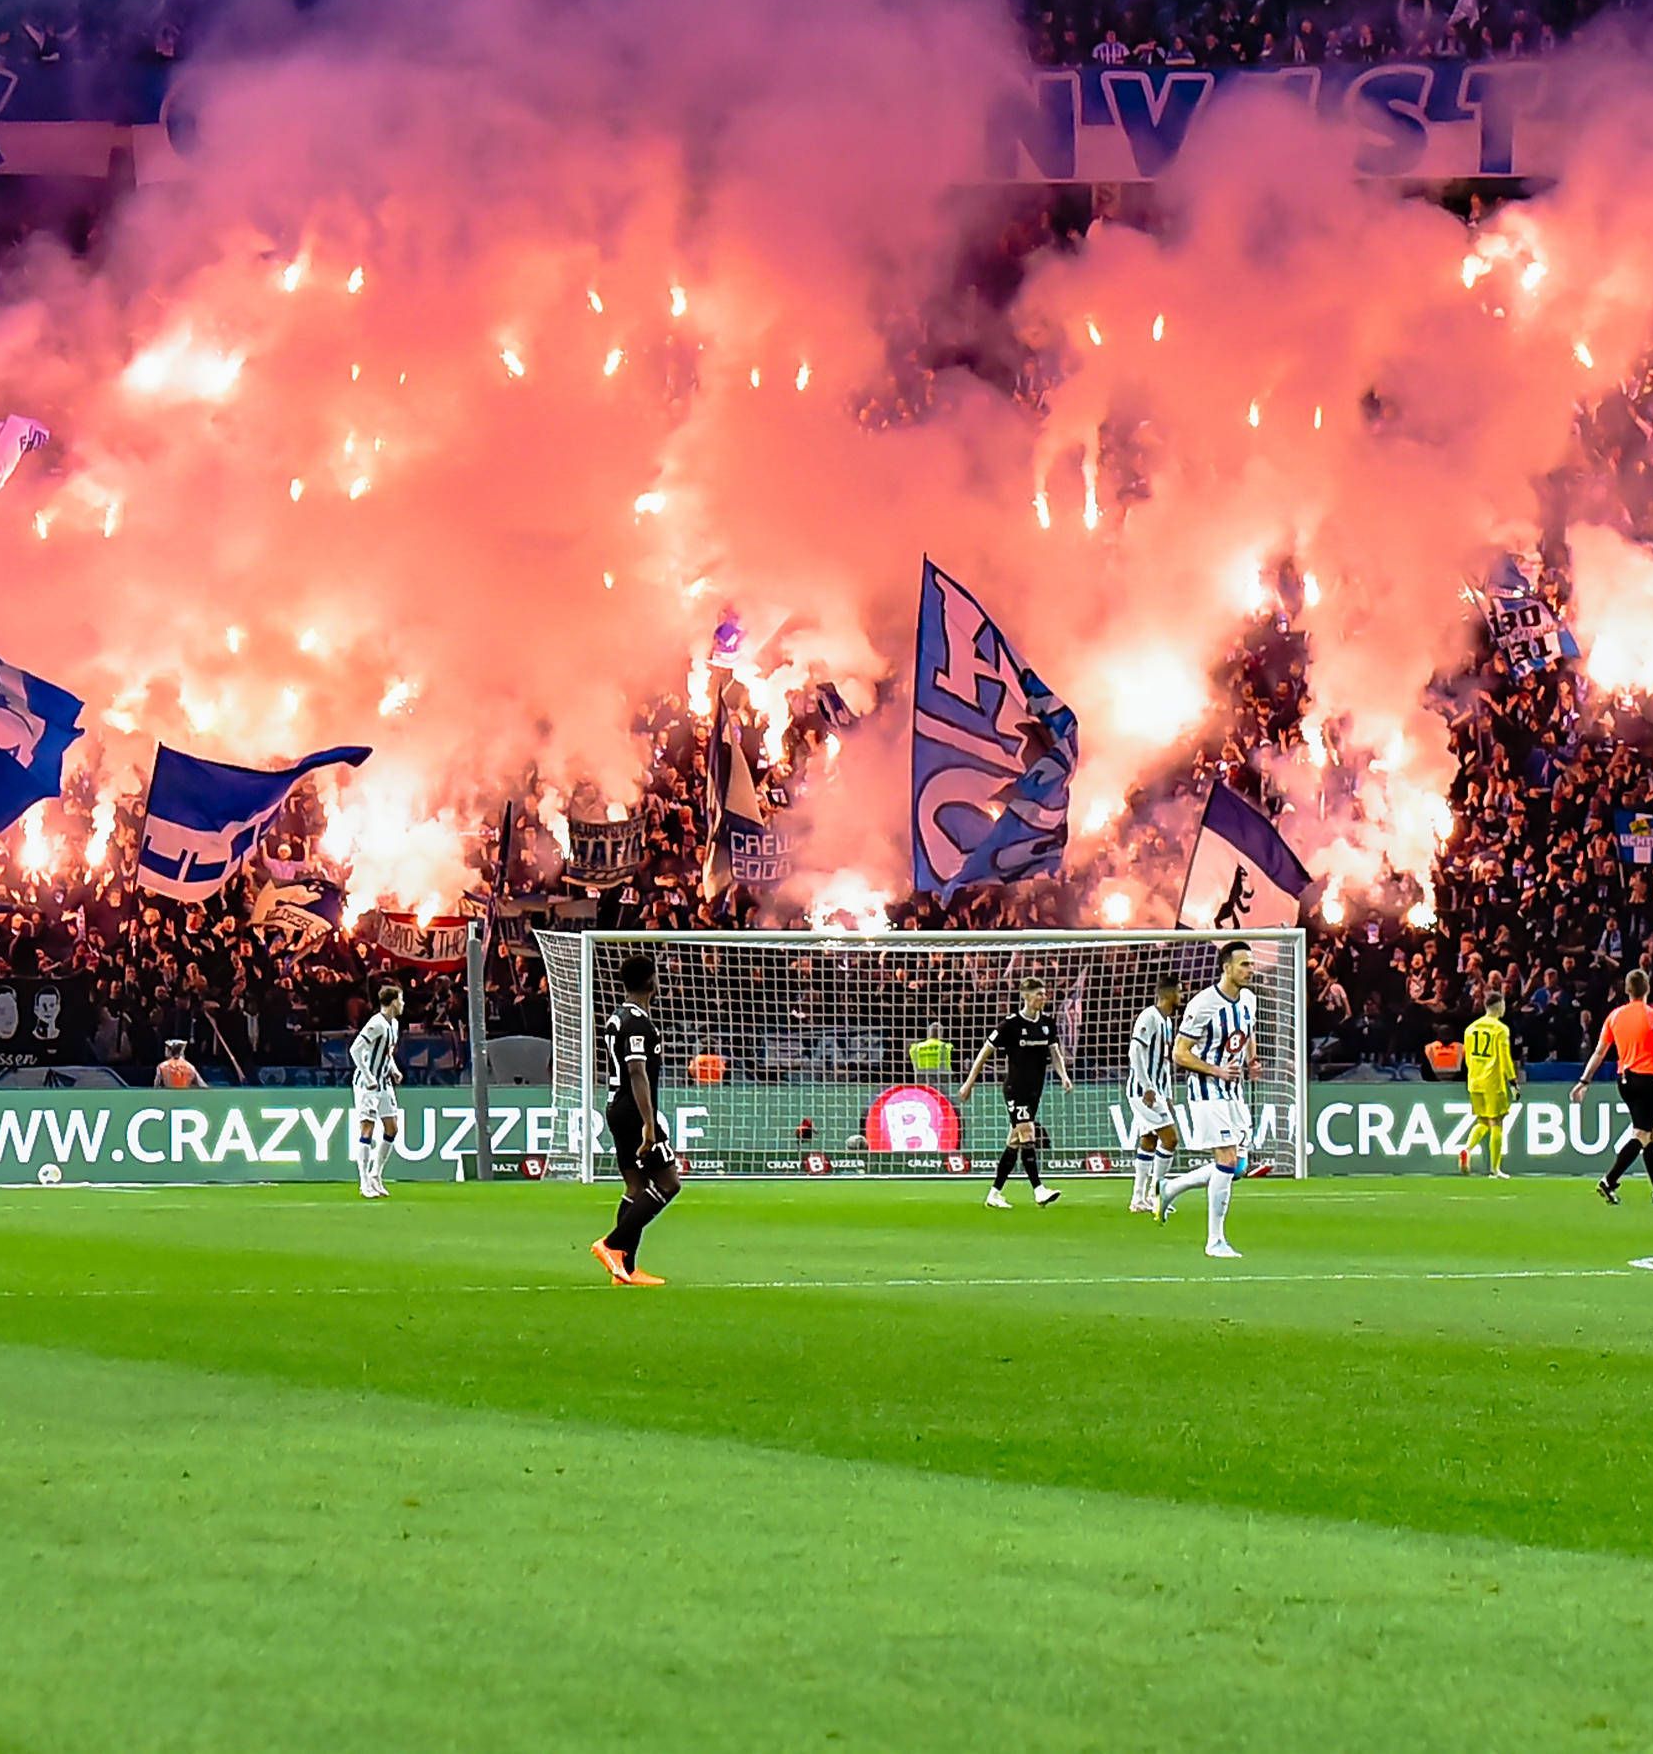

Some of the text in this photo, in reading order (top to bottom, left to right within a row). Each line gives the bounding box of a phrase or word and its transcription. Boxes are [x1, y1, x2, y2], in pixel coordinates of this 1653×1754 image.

[1471, 1031, 1492, 1057] 12
[882, 1100, 940, 1152] B
[491, 1162, 519, 1172] RAZY
[767, 1160, 802, 1170] CRAZY
